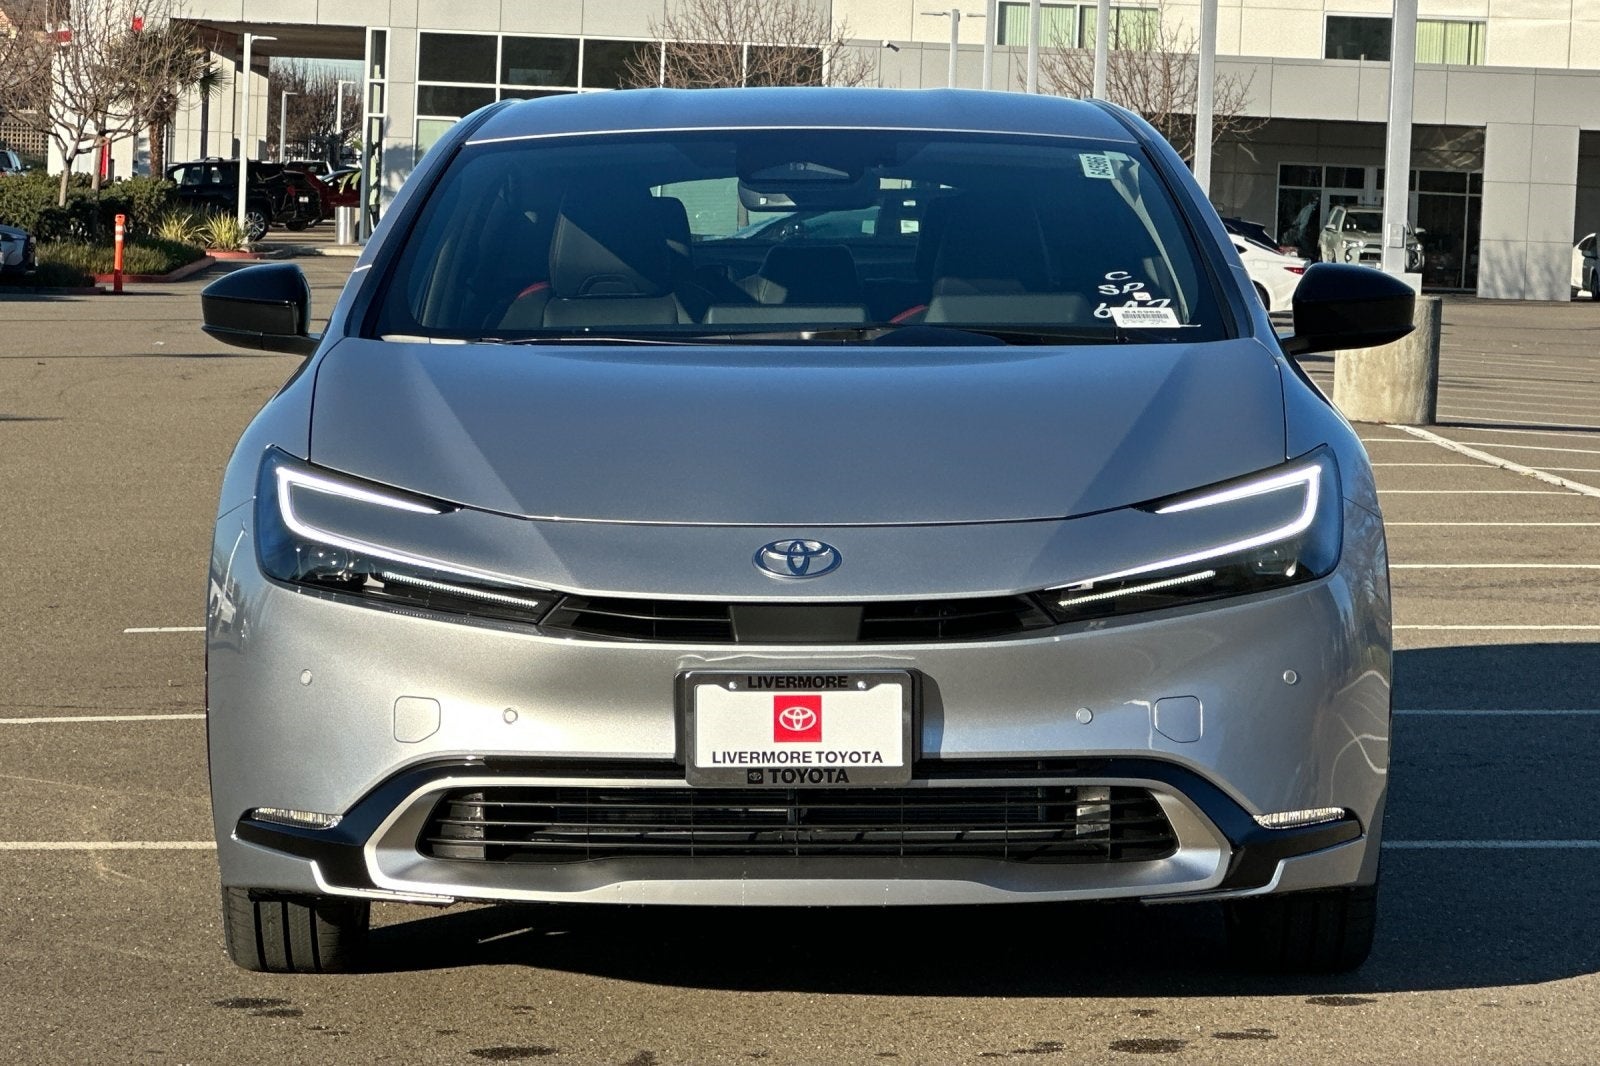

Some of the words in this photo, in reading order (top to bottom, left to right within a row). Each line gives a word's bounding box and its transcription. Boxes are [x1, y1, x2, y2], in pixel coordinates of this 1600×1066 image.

[1104, 271, 1132, 281] C
[747, 675, 848, 689] LIVERMORE
[712, 751, 812, 764] LIVERMORE
[817, 751, 883, 764] TOYOTA
[768, 768, 849, 784] TOYOTA
